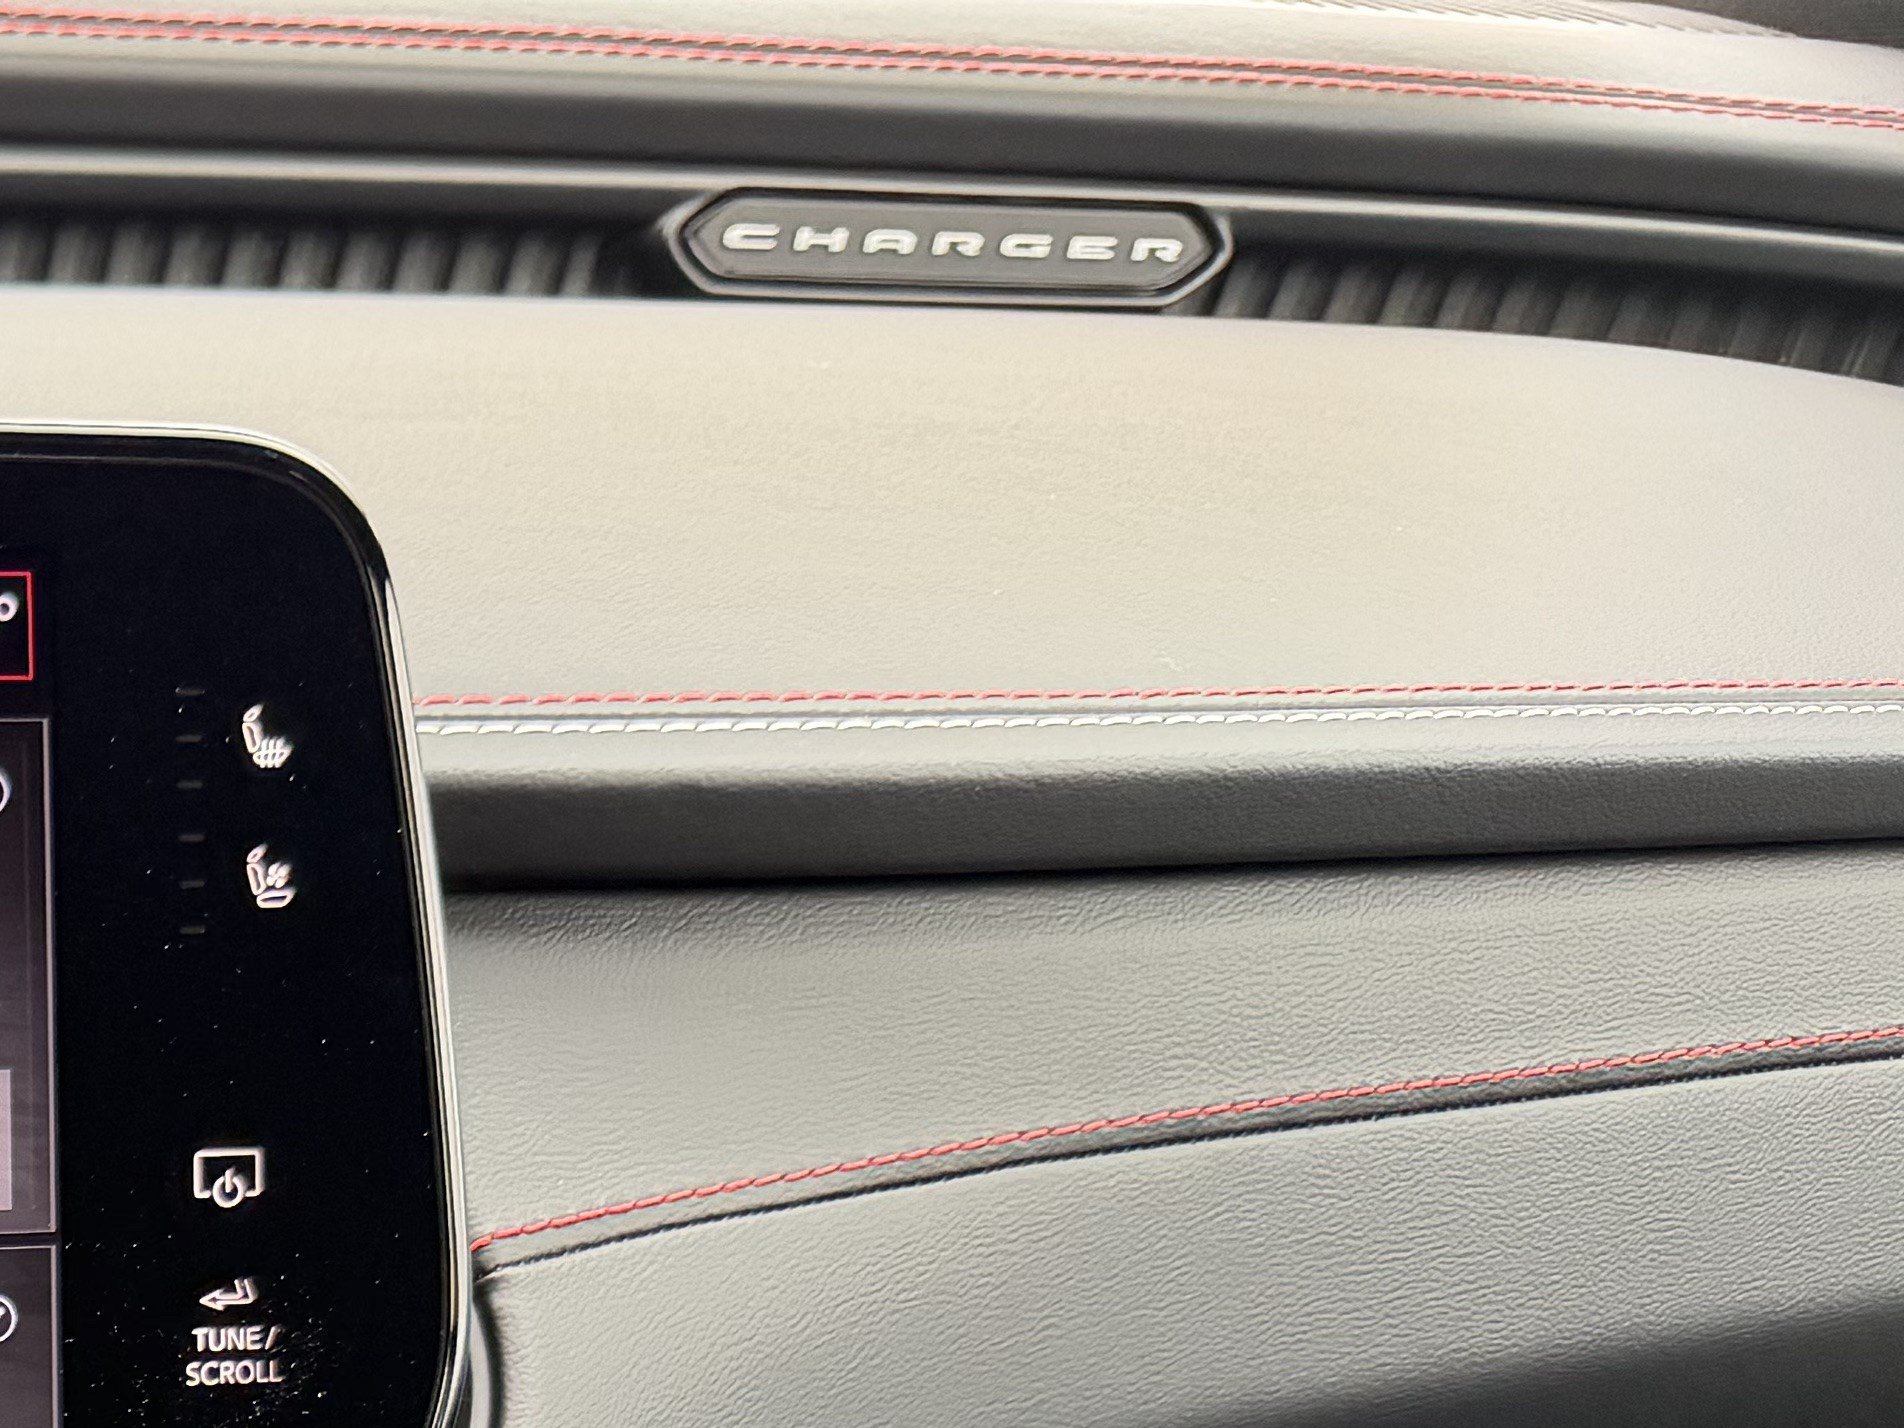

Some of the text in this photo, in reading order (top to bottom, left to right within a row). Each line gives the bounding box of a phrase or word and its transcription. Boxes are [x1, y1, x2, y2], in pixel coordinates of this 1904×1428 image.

[721, 222, 1184, 264] CHARGER
[192, 1326, 277, 1353] TUNE/
[186, 1361, 282, 1387] SCROLL
